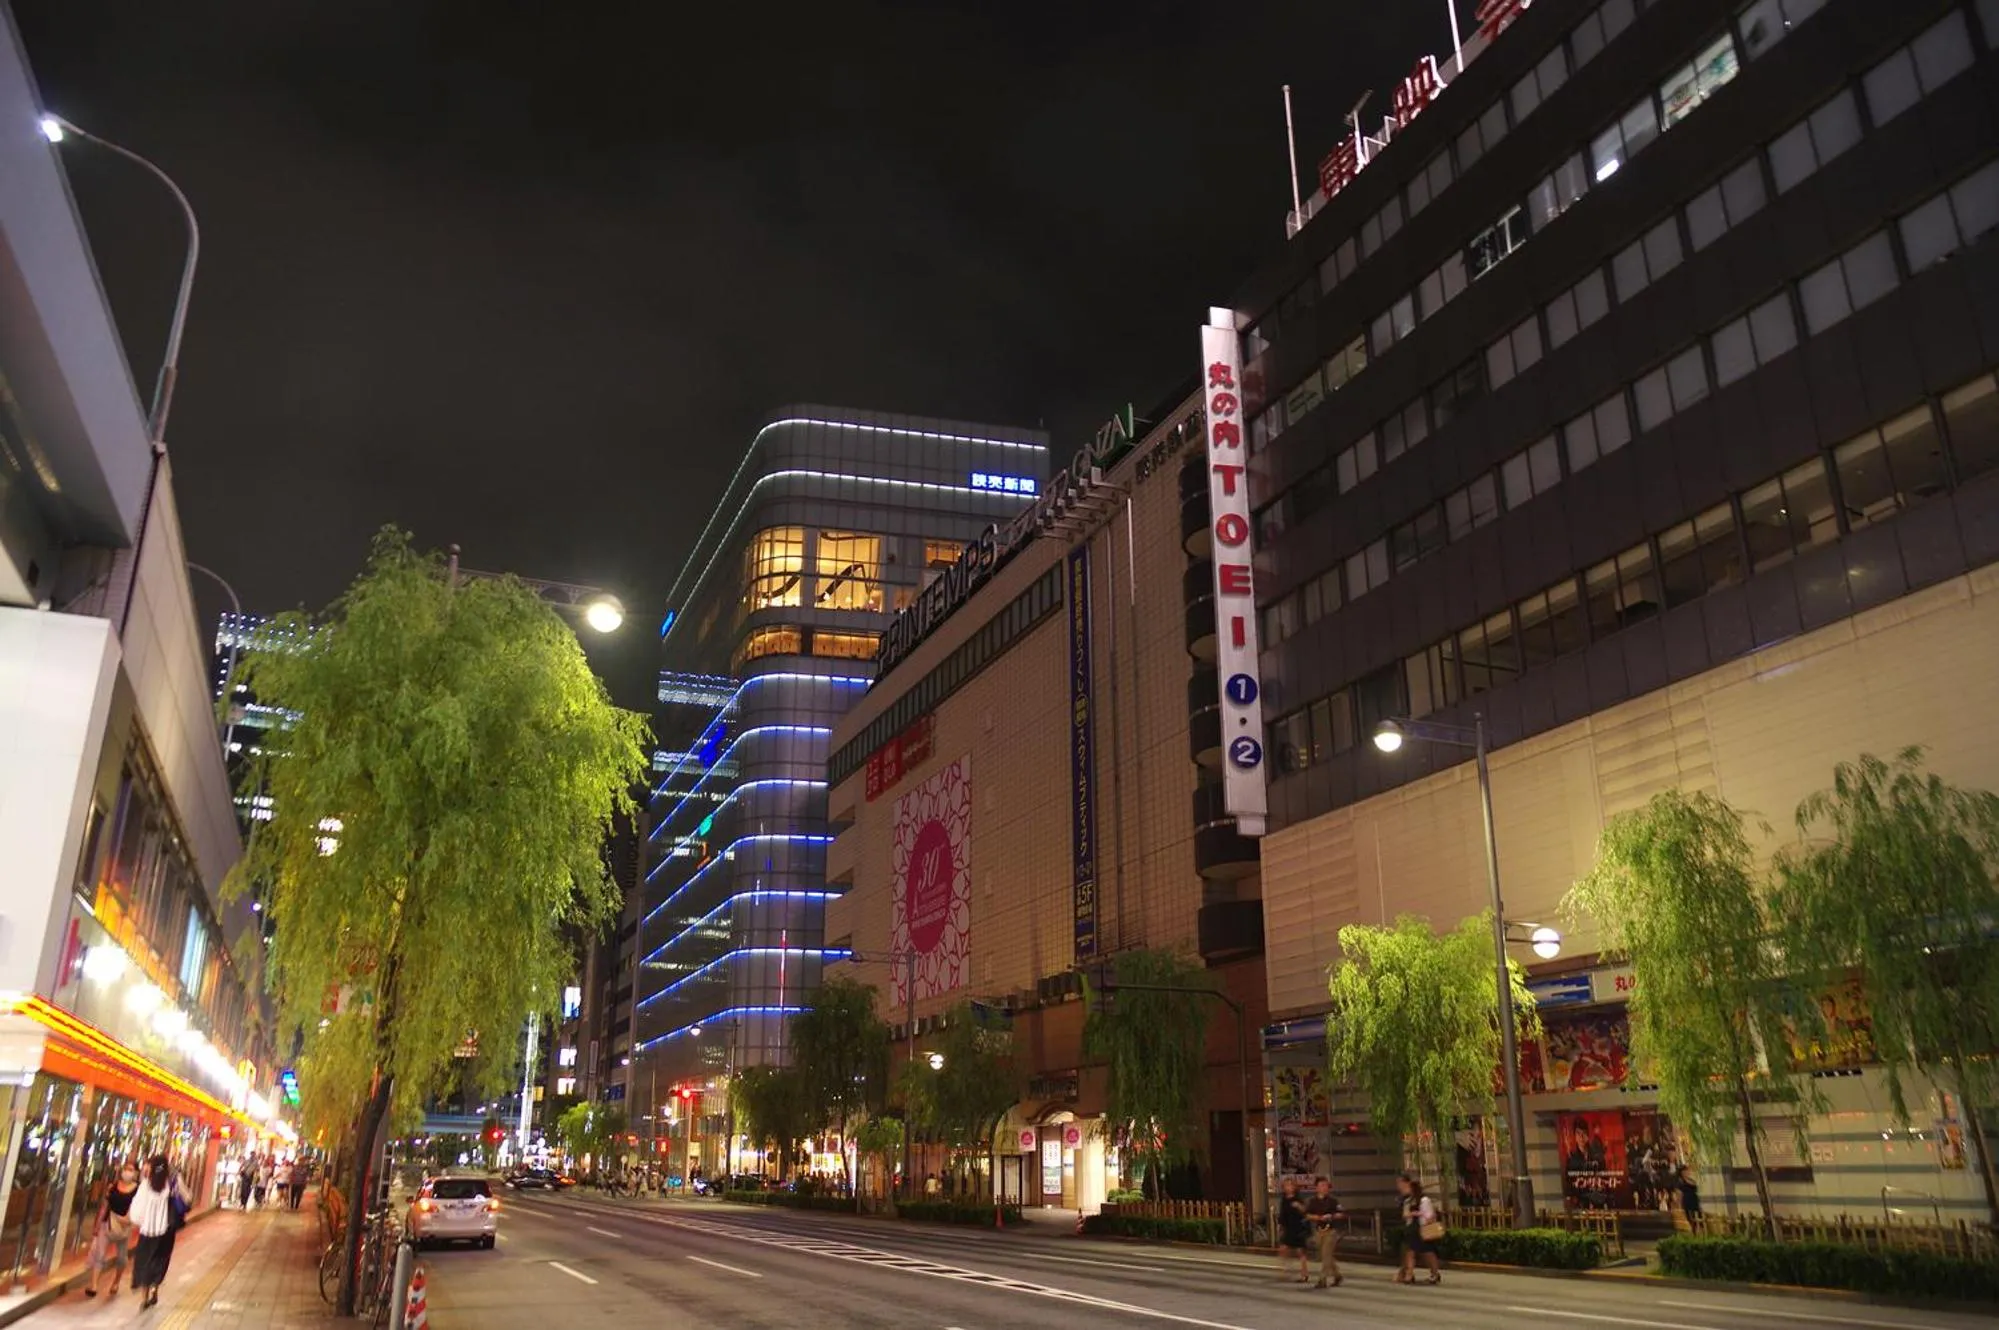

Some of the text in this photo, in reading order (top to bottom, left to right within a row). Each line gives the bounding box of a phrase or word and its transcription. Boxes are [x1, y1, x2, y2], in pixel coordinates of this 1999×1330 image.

[1208, 361, 1241, 449] 丸の内
[876, 523, 1000, 679] PRINTEMPS
[1213, 463, 1252, 648] TOEI
